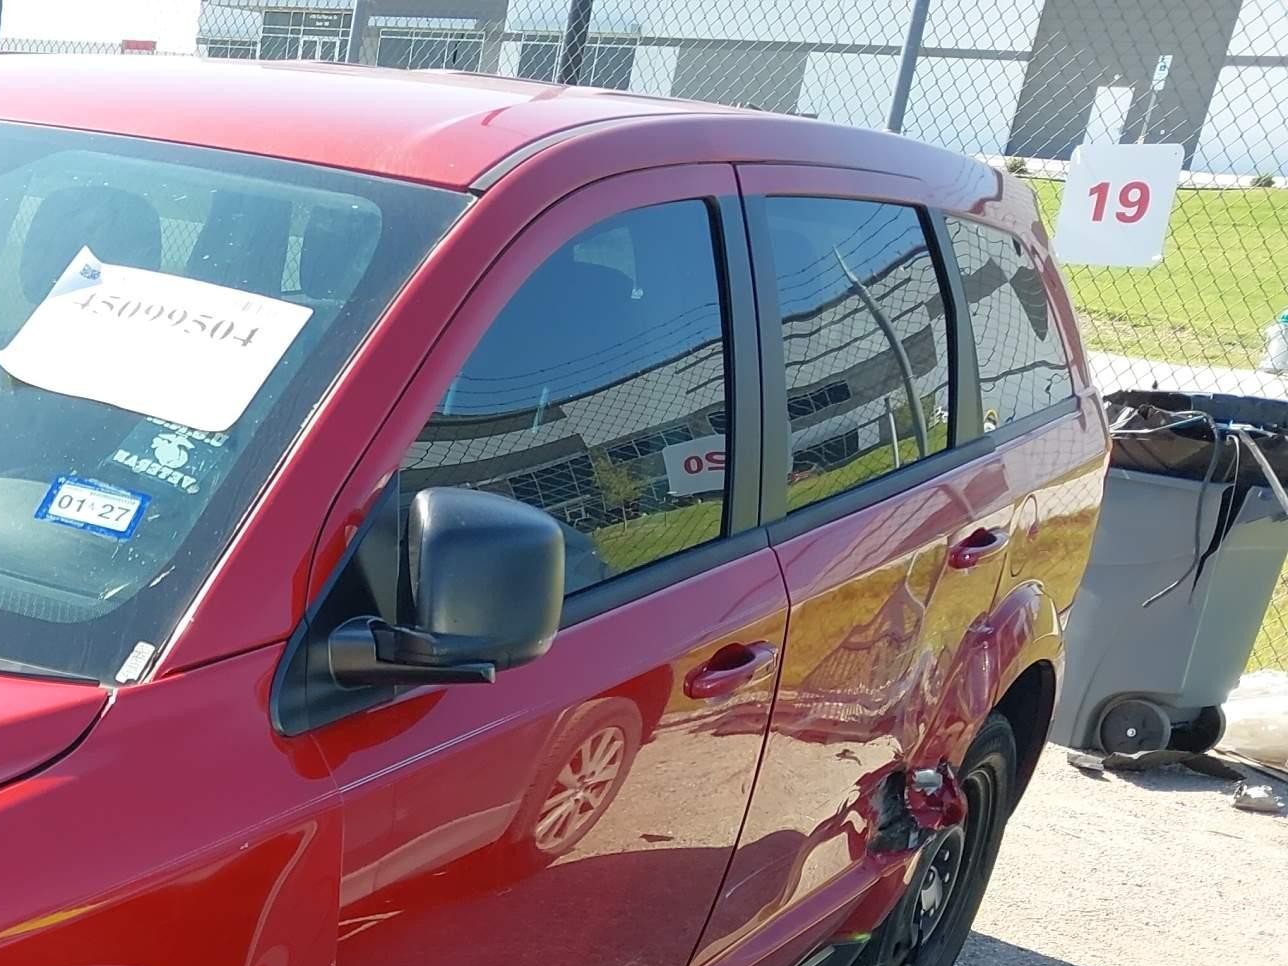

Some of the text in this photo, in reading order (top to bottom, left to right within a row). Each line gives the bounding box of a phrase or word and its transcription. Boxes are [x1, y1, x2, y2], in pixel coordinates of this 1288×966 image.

[1088, 181, 1151, 224] 19
[74, 292, 260, 347] 45099504
[57, 494, 87, 513] 01
[98, 503, 132, 522] 27
